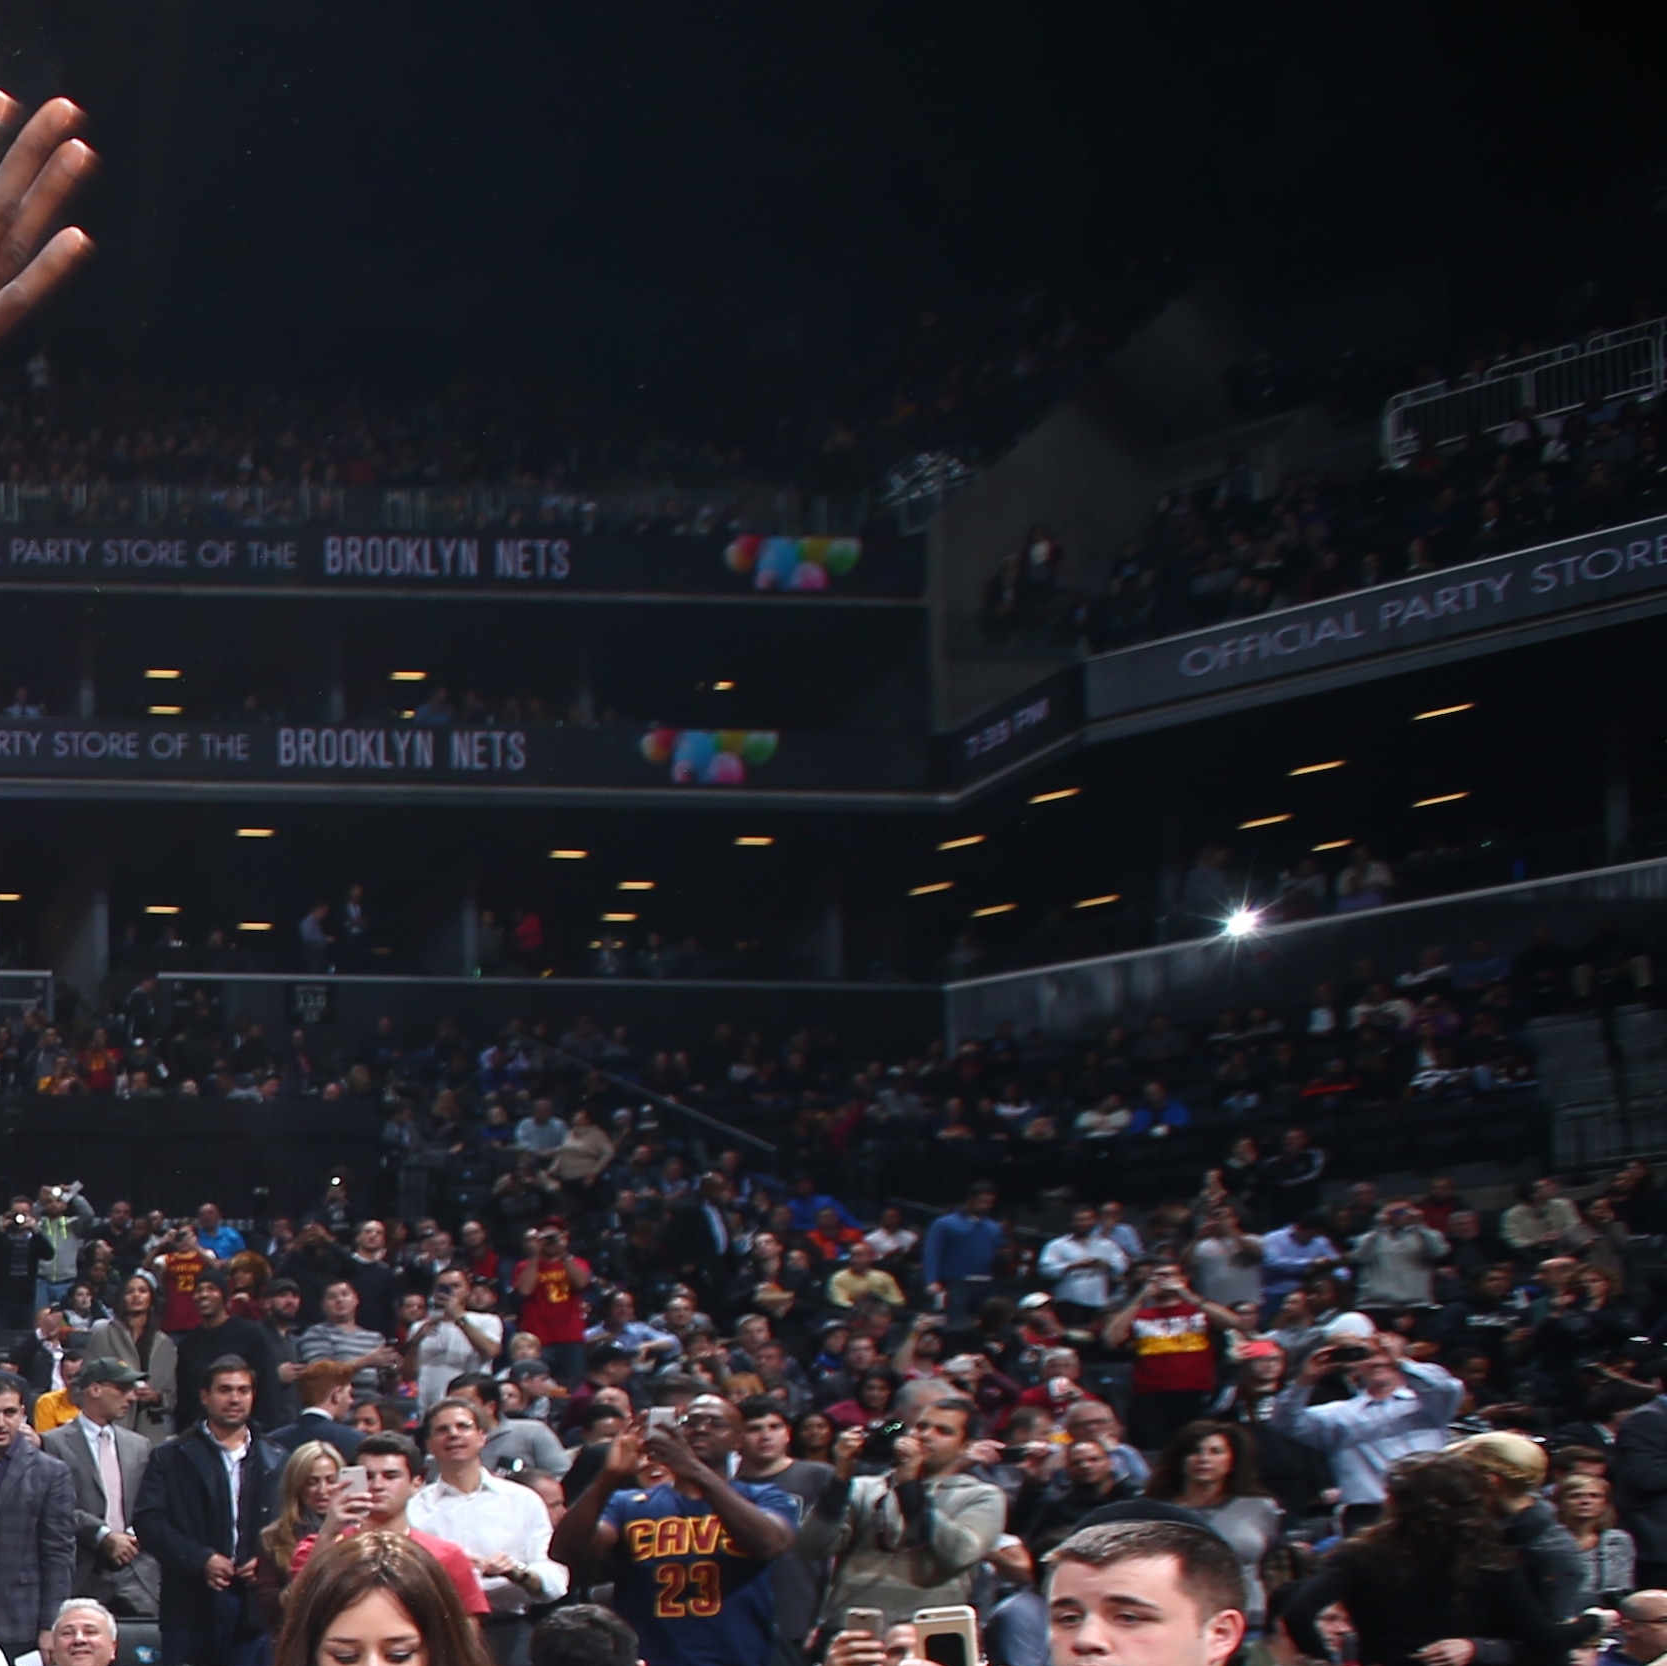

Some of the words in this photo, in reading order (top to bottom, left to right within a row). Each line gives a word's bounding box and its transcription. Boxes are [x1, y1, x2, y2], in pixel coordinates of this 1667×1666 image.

[9, 537, 92, 564] PARTY
[101, 540, 188, 569] STORE
[198, 540, 239, 569] OF
[247, 540, 297, 570] THE
[323, 538, 479, 577] BROOKLYN
[495, 539, 571, 578] NETS
[1178, 608, 1365, 679] OFFICIAL
[1378, 572, 1512, 631] PARTY
[51, 730, 140, 760] STORE
[147, 732, 190, 761] OF
[199, 733, 251, 762] THE
[277, 728, 434, 769] BROOKLYN
[450, 730, 527, 771] NETS
[654, 1559, 723, 1619] 23
